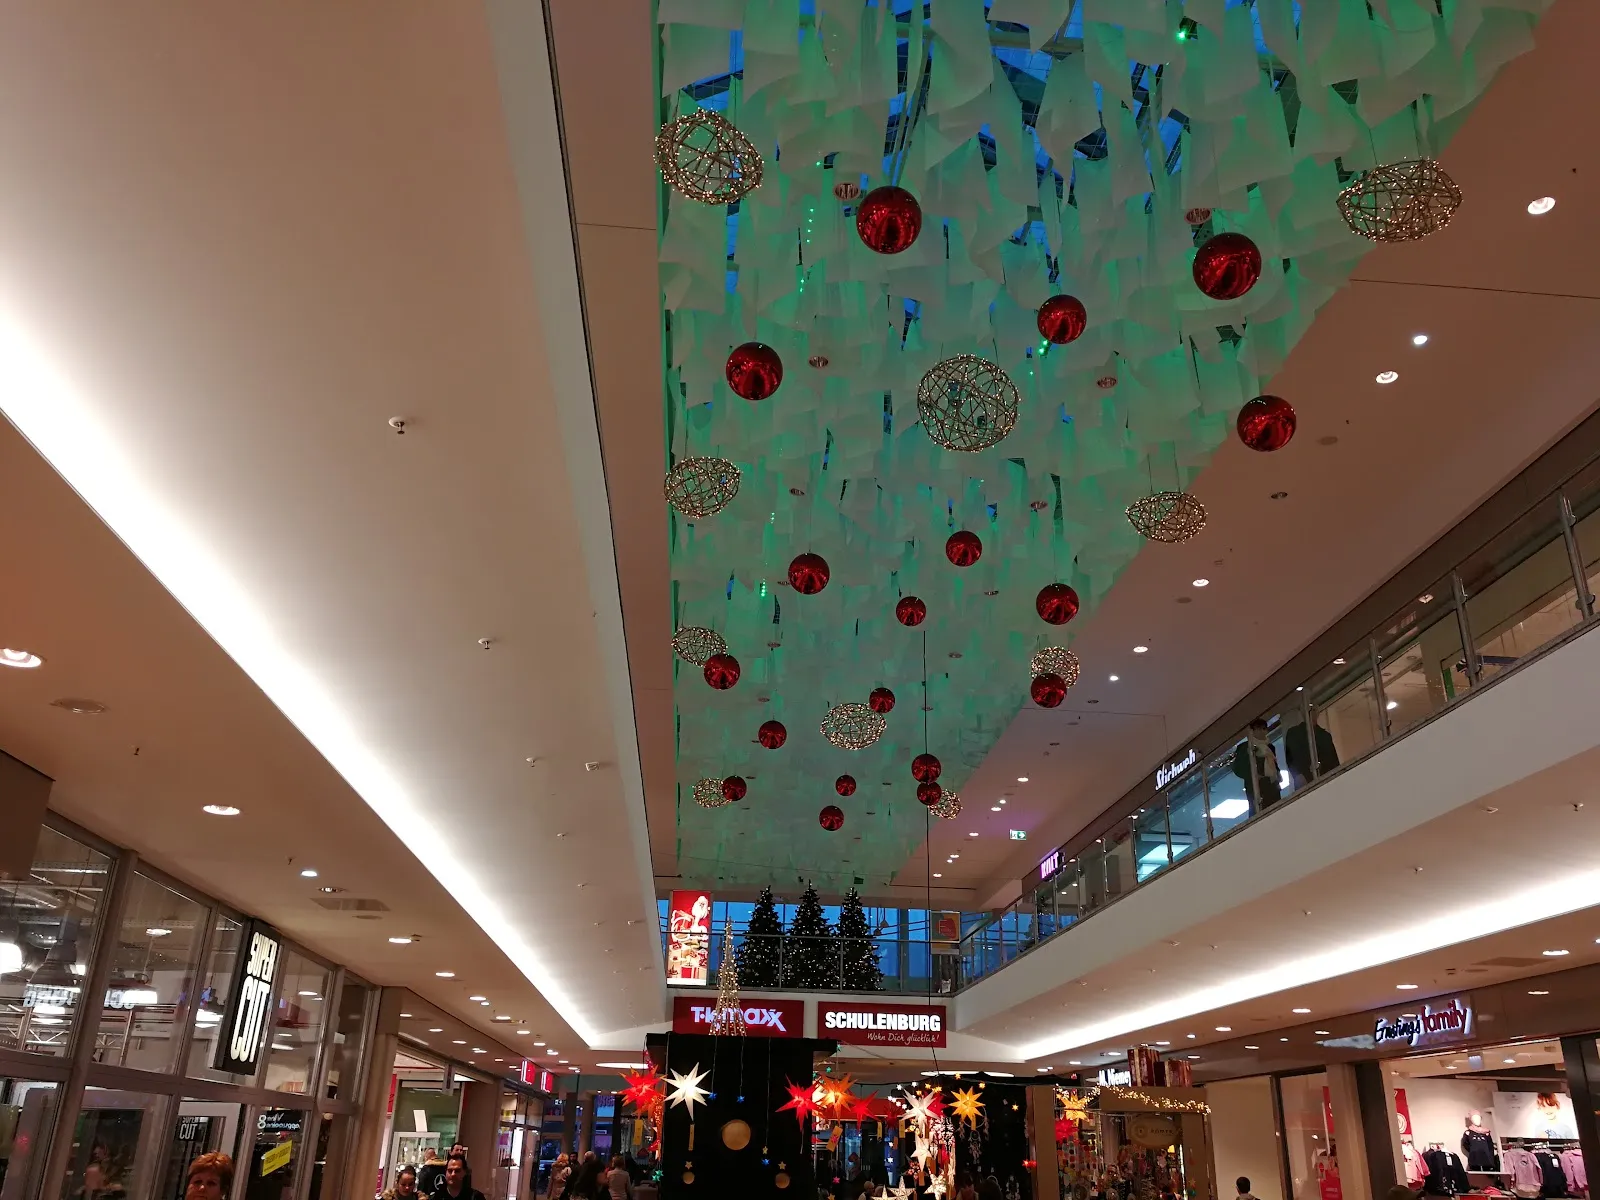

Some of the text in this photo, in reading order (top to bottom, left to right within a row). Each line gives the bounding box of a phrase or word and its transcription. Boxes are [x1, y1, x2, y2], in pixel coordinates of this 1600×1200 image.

[247, 932, 278, 982] SUPER
[231, 976, 271, 1062] CUT
[825, 1011, 941, 1031] SCHULENBURG
[1421, 999, 1471, 1035] family
[867, 1032, 886, 1041] Wohn
[888, 1032, 905, 1042] Dich
[179, 1123, 198, 1140] CUT
